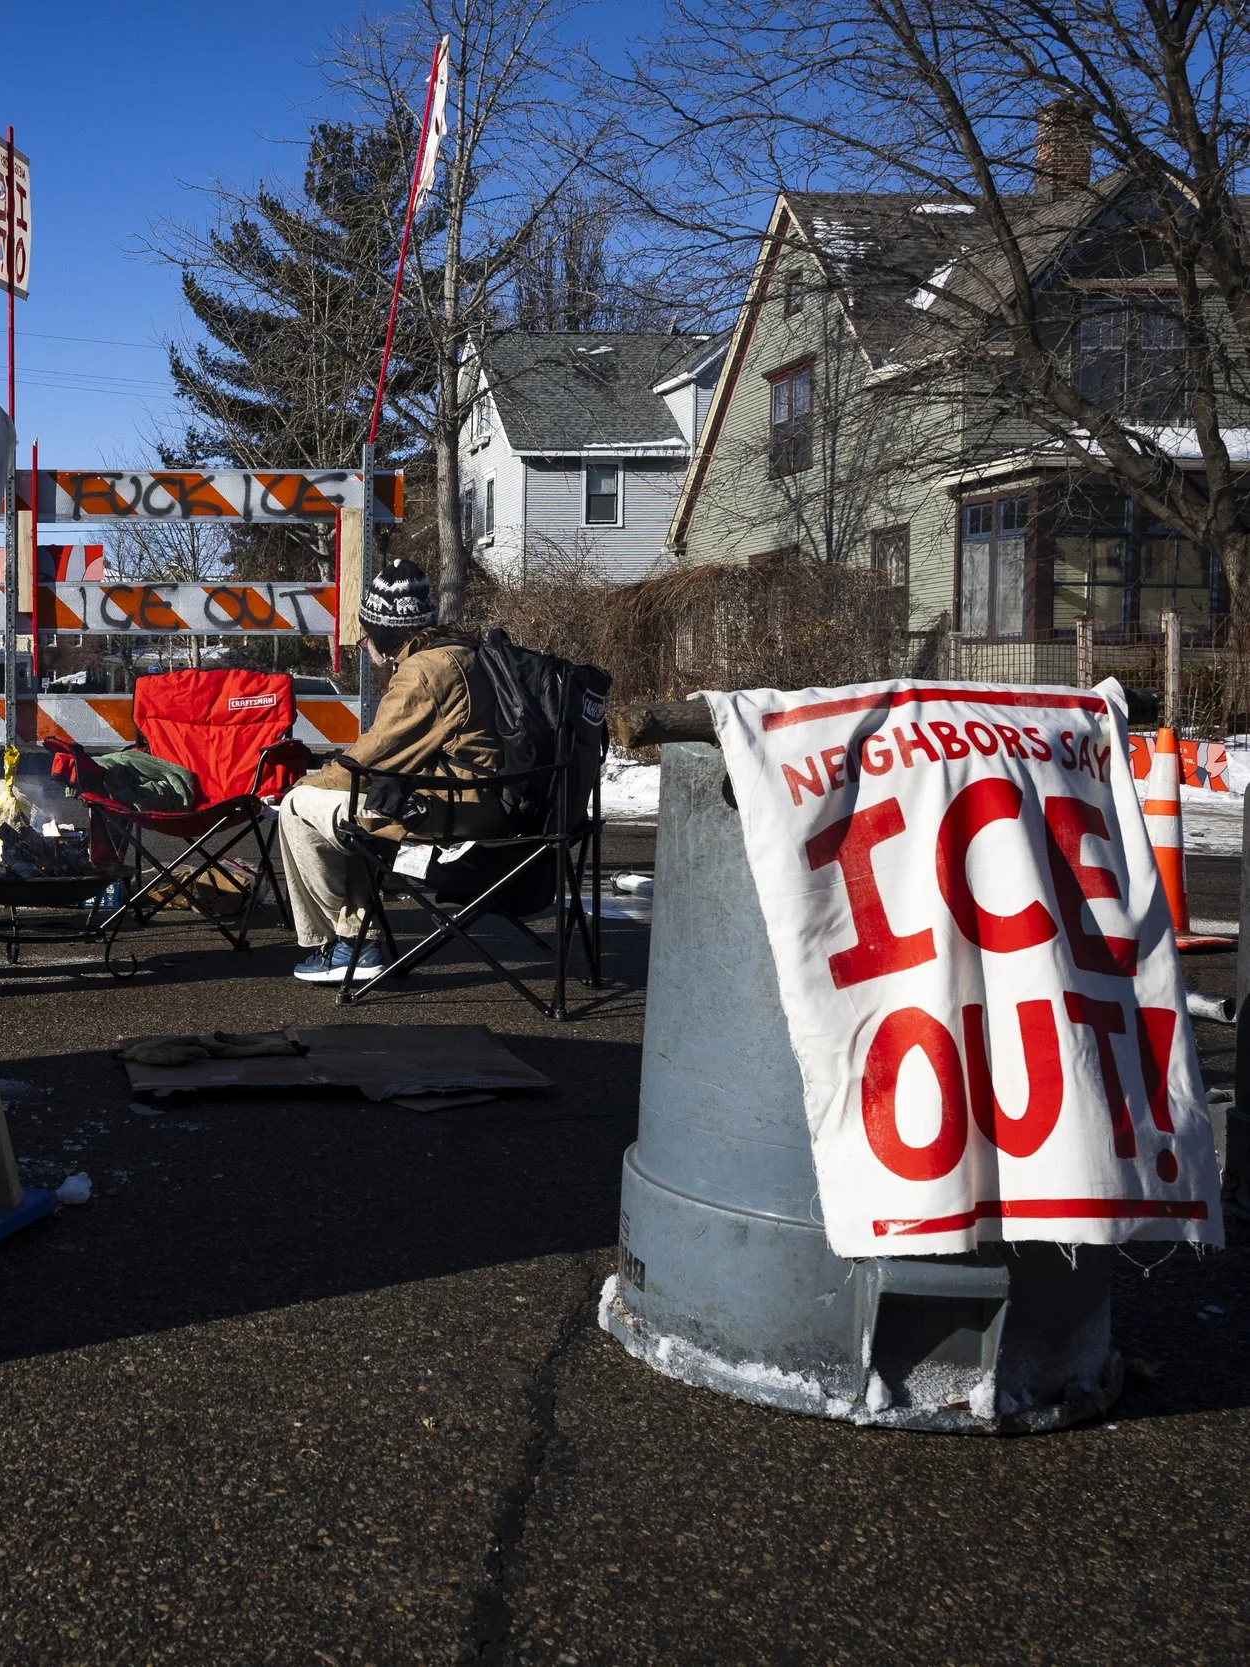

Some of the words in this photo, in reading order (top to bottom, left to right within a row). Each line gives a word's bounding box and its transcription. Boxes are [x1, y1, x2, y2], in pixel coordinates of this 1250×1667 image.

[68, 472, 224, 521] FUCK
[242, 471, 348, 522] ICE
[78, 583, 180, 631] ICE
[204, 583, 325, 635] OUT
[230, 696, 274, 708] CRAFTSMAN
[780, 720, 1054, 807] NEIGHBORS
[1059, 730, 1111, 783] SAY
[805, 776, 1140, 990] ICE
[861, 991, 1177, 1184] OUT!
